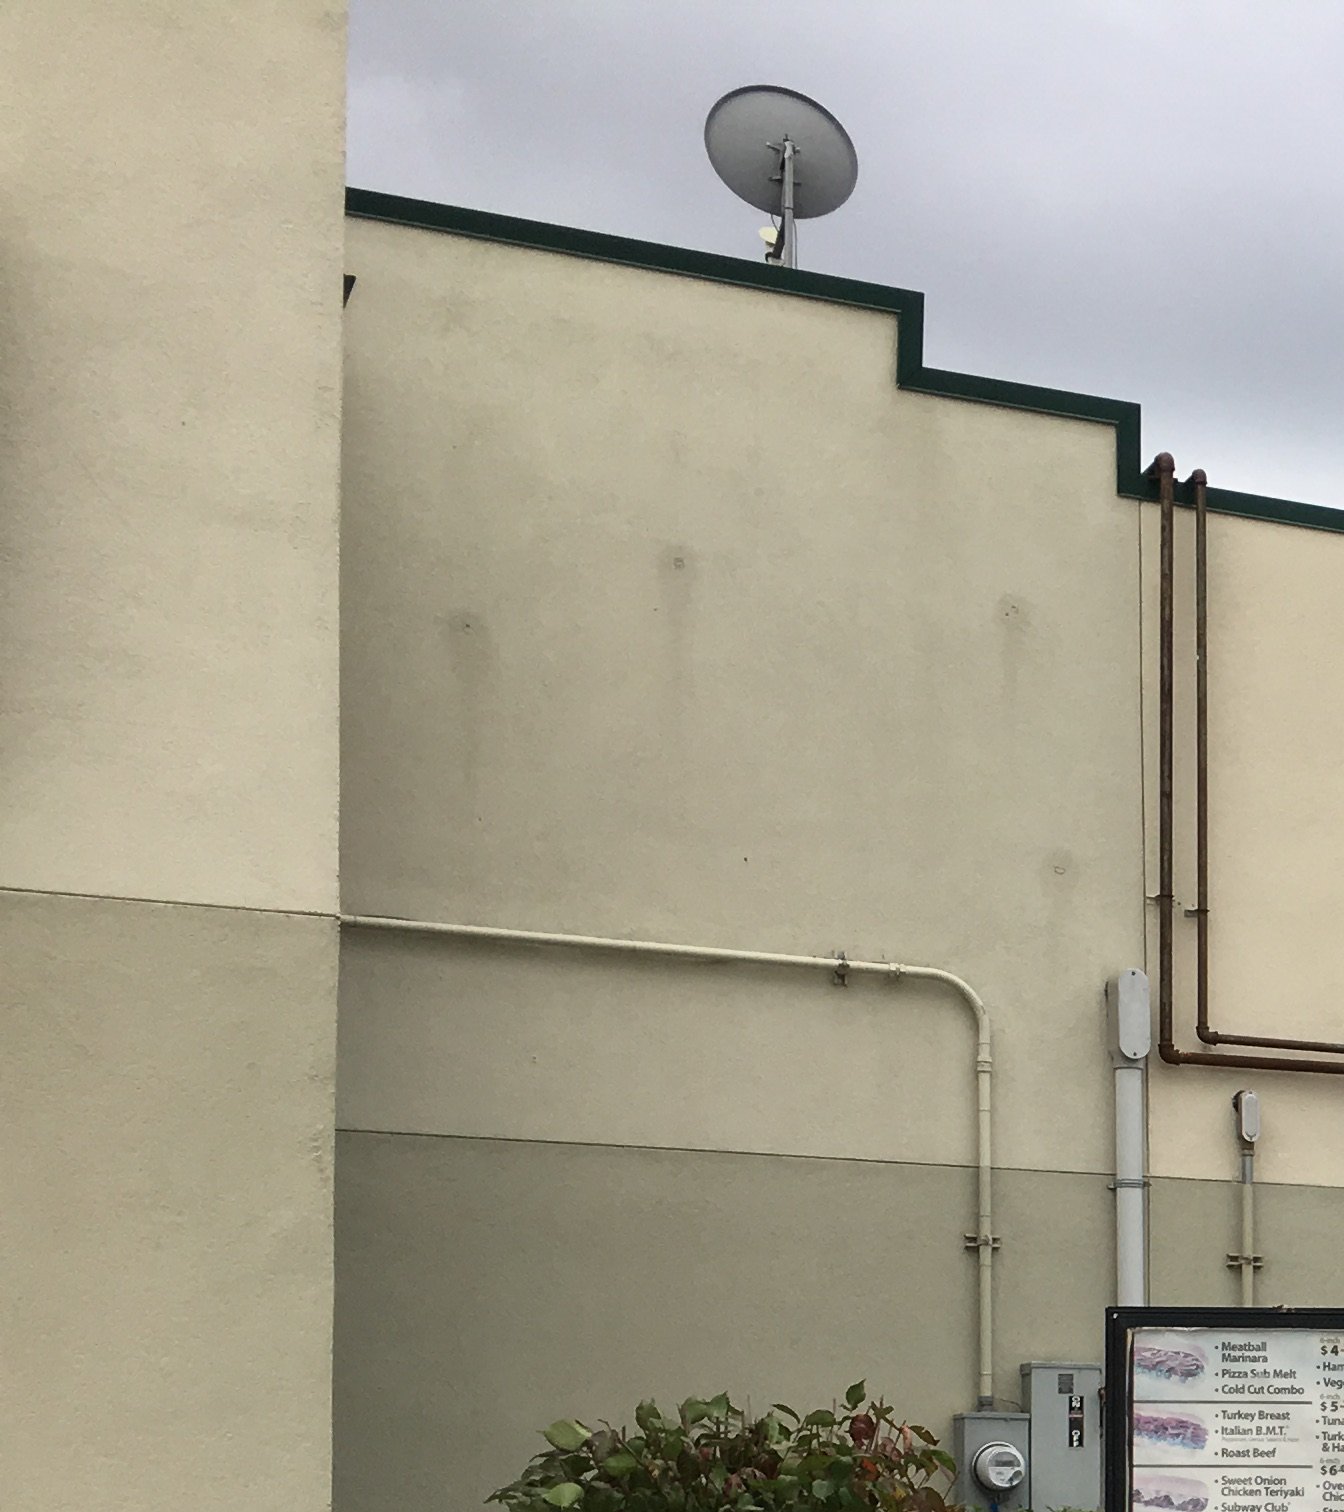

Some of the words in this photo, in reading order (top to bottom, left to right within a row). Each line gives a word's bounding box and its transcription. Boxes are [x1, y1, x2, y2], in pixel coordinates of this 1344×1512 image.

[1222, 1343, 1267, 1352] Meatball
[1222, 1354, 1268, 1363] Marinara
[1222, 1369, 1247, 1379] Pizza
[1251, 1369, 1270, 1379] Sub
[1273, 1369, 1296, 1379] Melt
[1222, 1385, 1245, 1395] Cold
[1248, 1385, 1264, 1395] Cut
[1267, 1385, 1304, 1395] Combo
[1222, 1411, 1255, 1421] Turkey
[1258, 1411, 1290, 1420] Breast
[1221, 1427, 1251, 1435] Italian
[1222, 1449, 1249, 1457] Roast
[1253, 1448, 1276, 1457] Beef
[1322, 1444, 1330, 1452] &
[1221, 1476, 1251, 1485] Sweet
[1255, 1476, 1286, 1485] Onion
[1221, 1487, 1262, 1497] Chicken
[1264, 1487, 1304, 1499] Teriyaki
